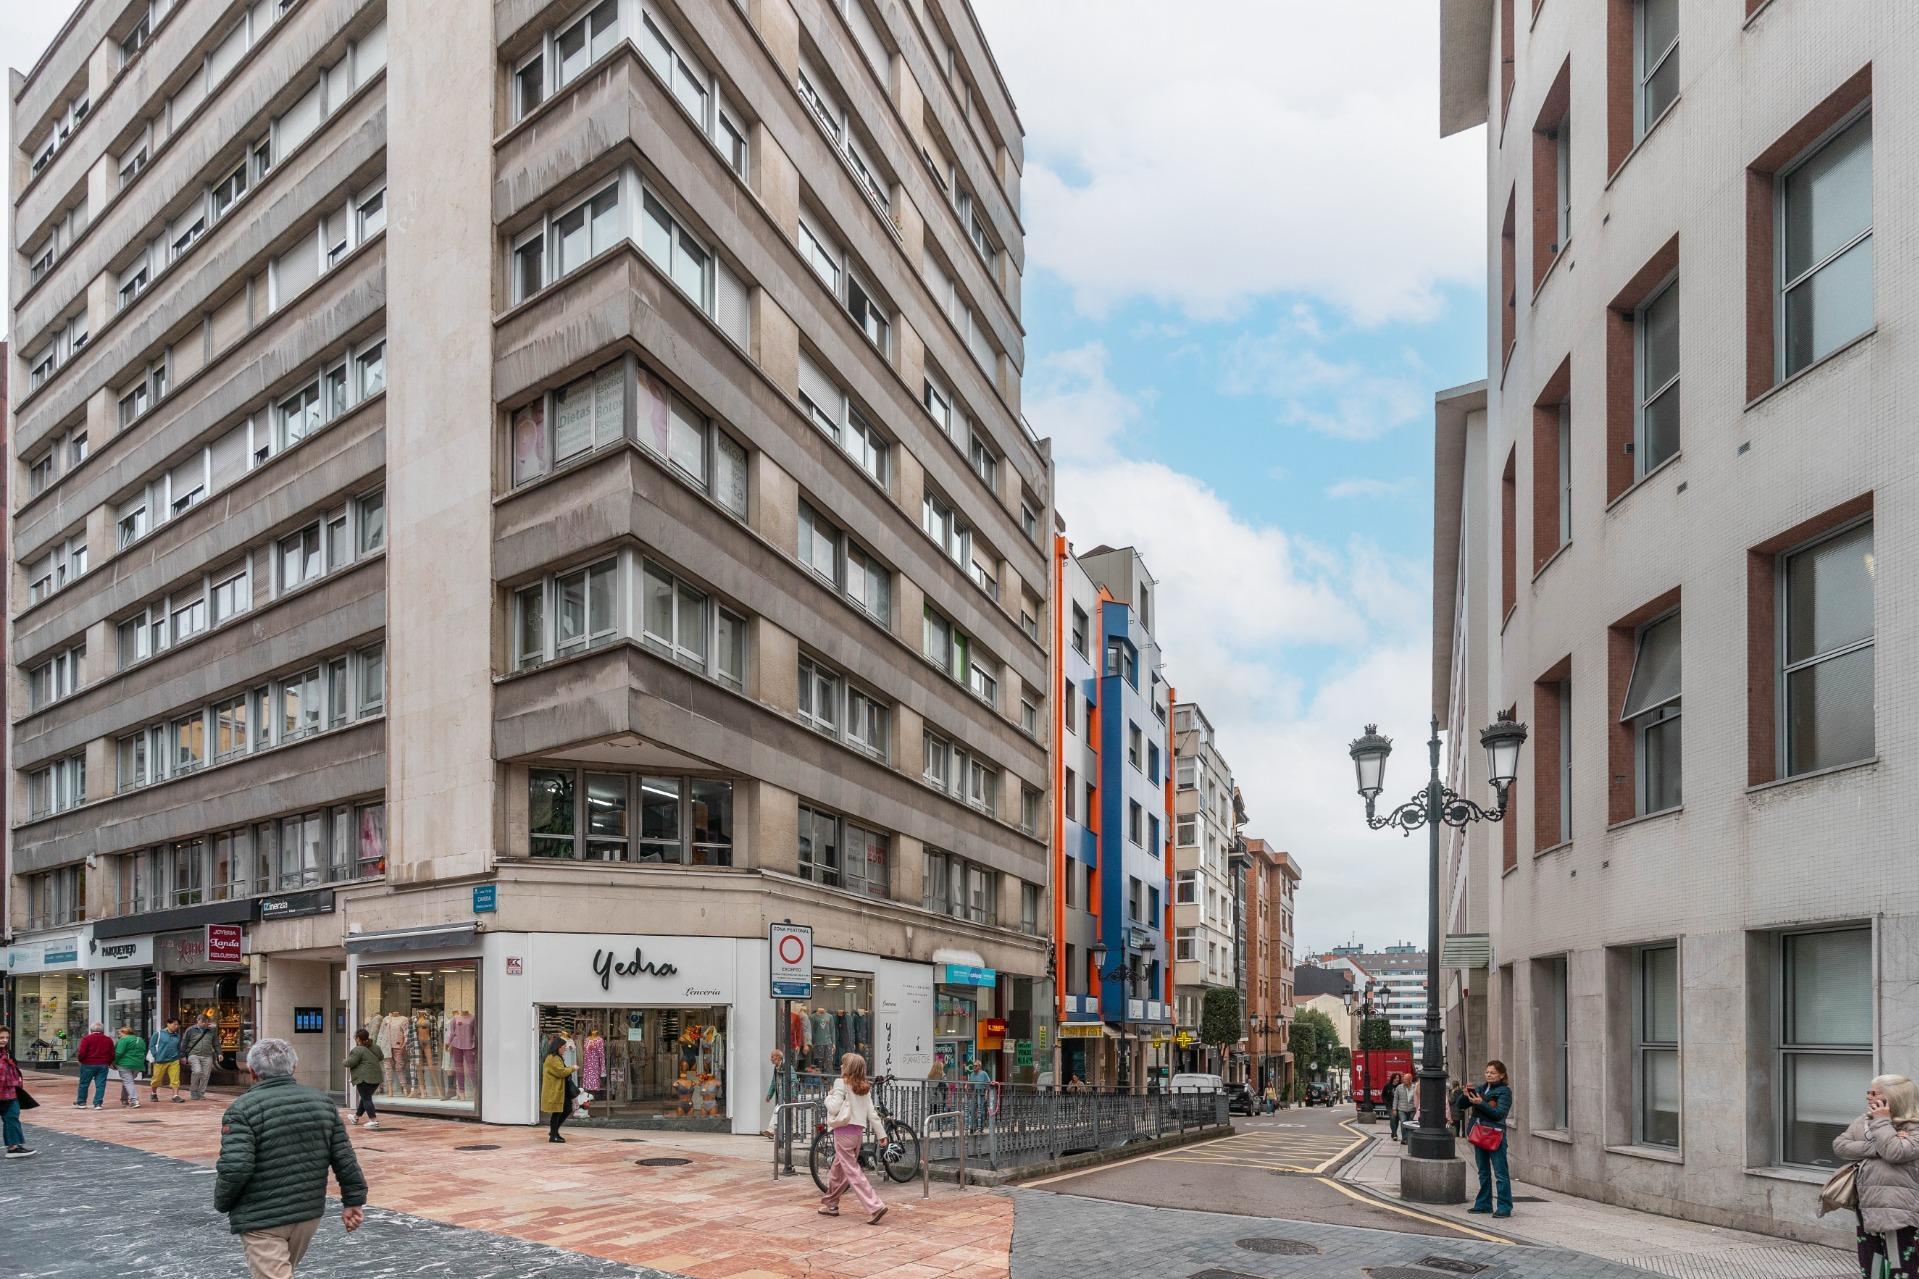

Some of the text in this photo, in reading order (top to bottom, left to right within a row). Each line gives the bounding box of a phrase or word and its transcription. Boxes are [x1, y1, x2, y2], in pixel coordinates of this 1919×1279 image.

[559, 404, 592, 429] Dietas
[210, 938, 239, 949] Landa
[593, 947, 678, 991] Yedra
